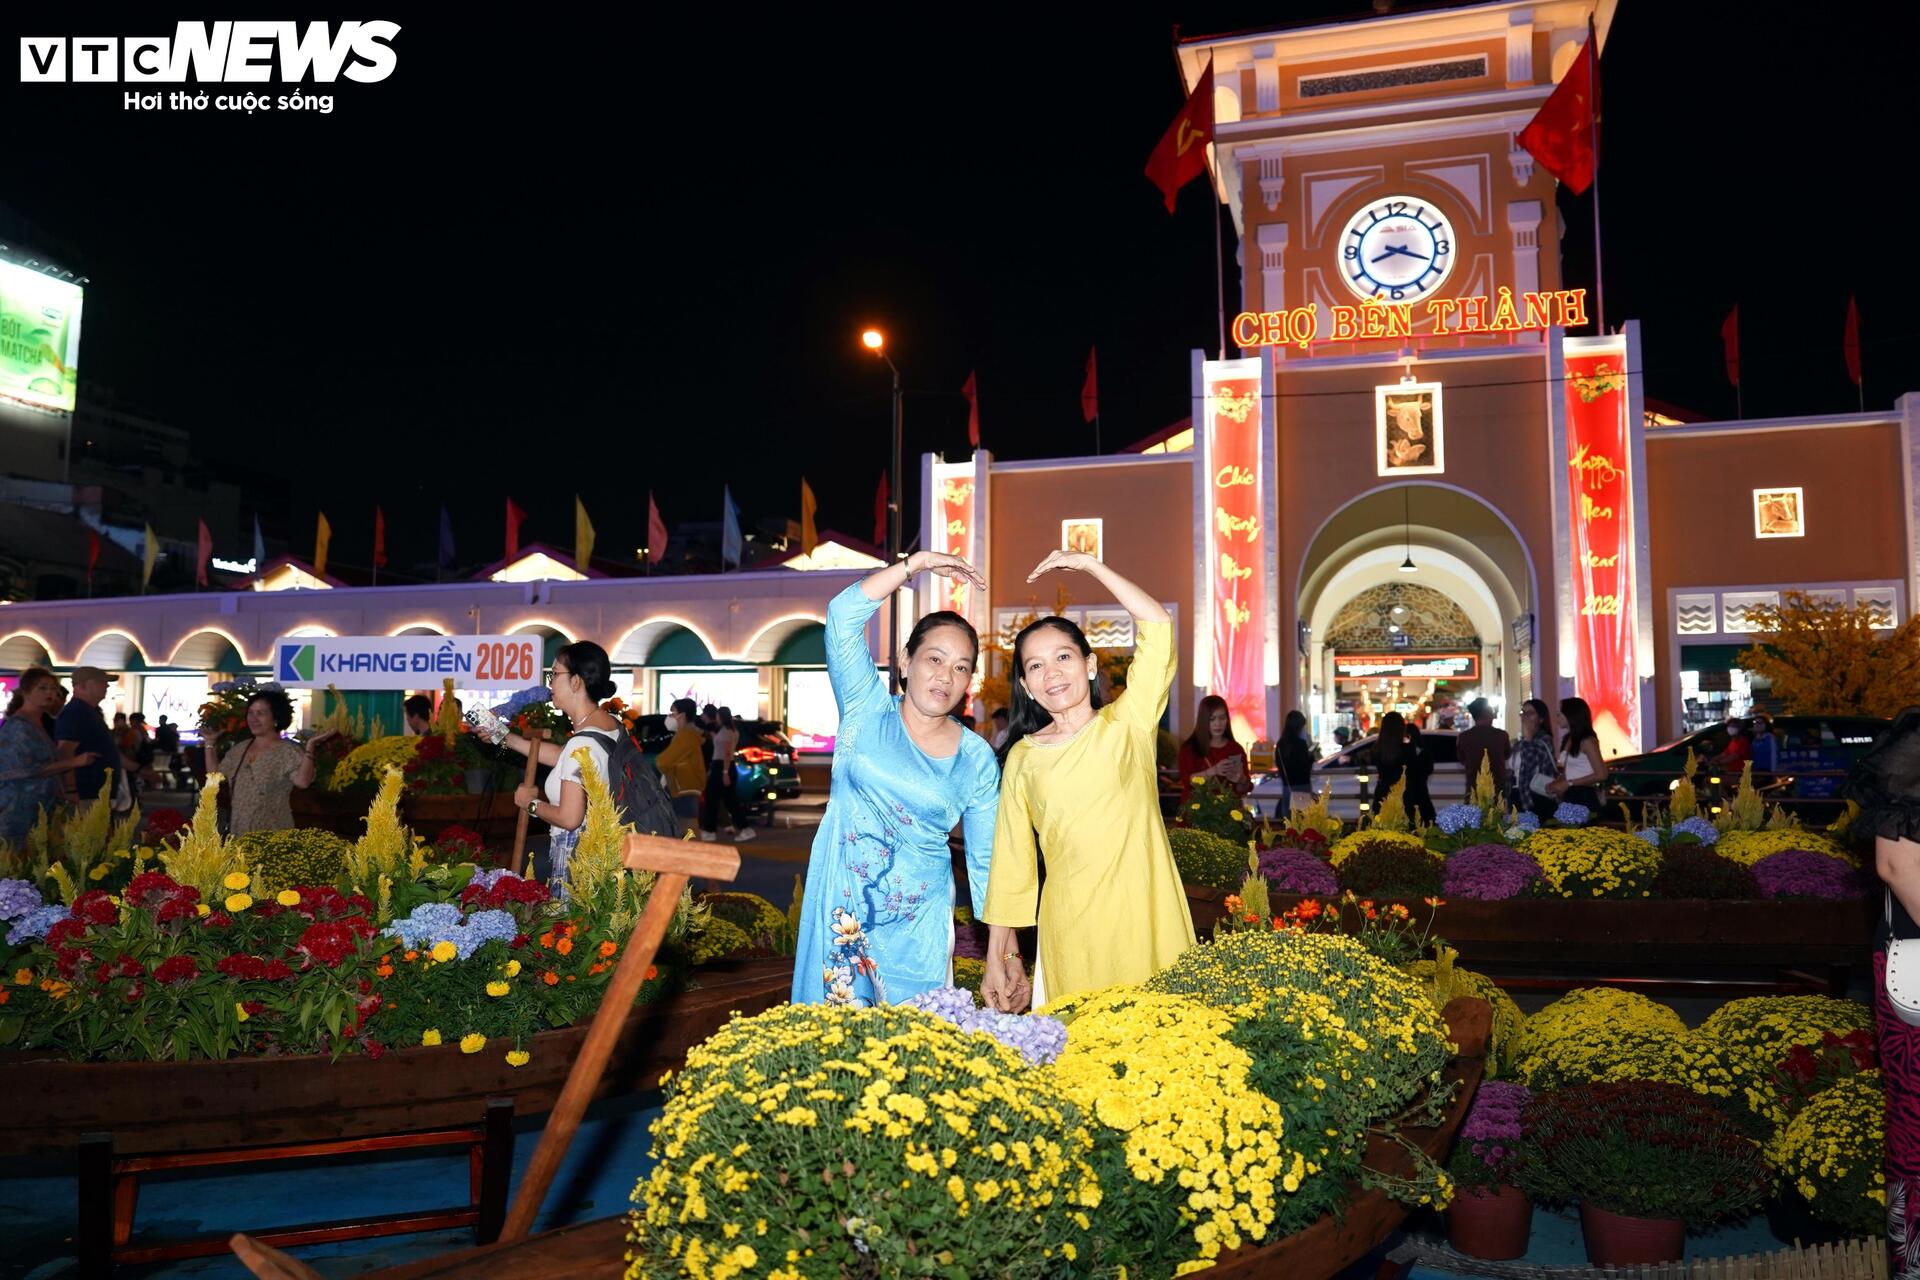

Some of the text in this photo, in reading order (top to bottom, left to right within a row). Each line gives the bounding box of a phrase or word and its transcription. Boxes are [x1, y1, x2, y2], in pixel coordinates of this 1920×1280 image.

[1384, 201, 1408, 217] 12
[1344, 245, 1358, 260] 9
[1436, 240, 1450, 255] 3
[1391, 286, 1405, 300] 6
[1232, 286, 1589, 348] CHỢ BẾN THÀNH
[1215, 464, 1256, 488] Chúc
[320, 640, 533, 680] KHANG ĐIỀN 2026
